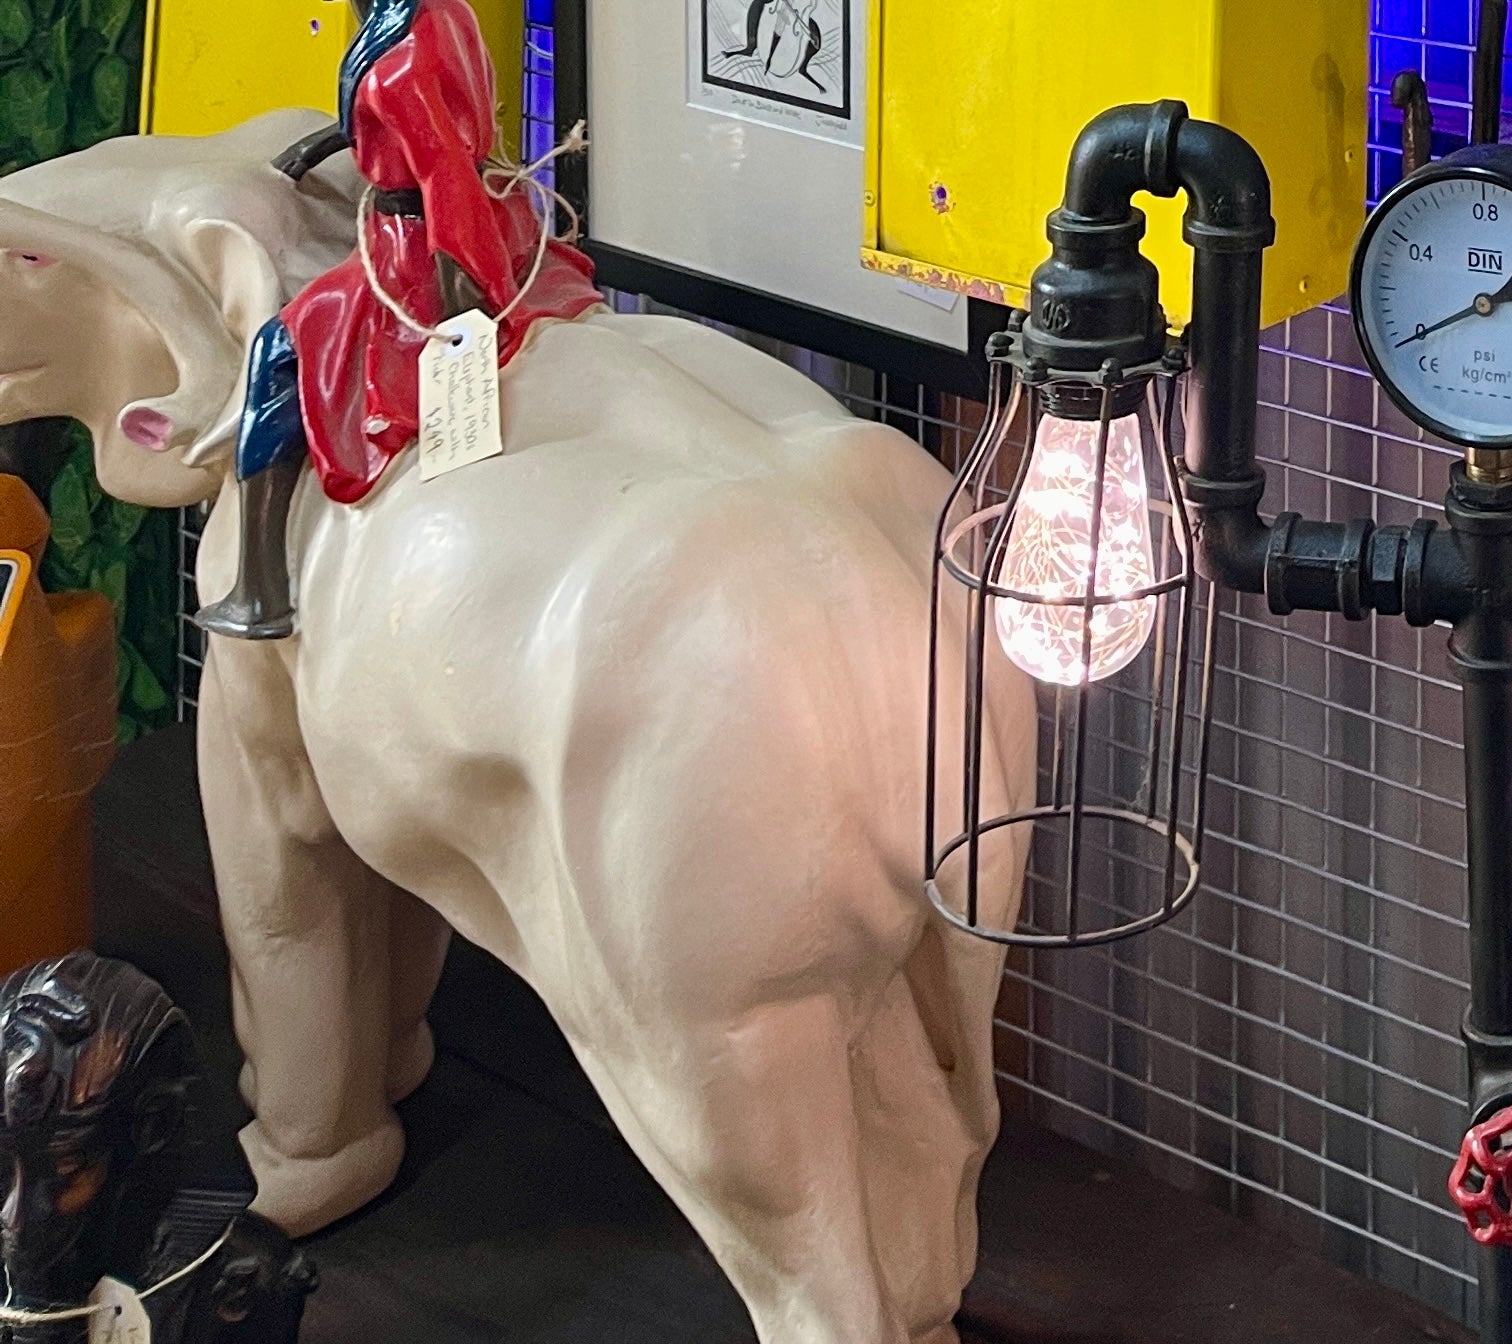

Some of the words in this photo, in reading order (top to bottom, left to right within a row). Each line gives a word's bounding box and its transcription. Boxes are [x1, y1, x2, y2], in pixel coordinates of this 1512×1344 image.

[1472, 202, 1499, 222] 0.8
[1409, 243, 1433, 263] 0.4
[1467, 250, 1503, 271] DIN
[1415, 323, 1427, 340] 0
[1473, 349, 1496, 363] psi
